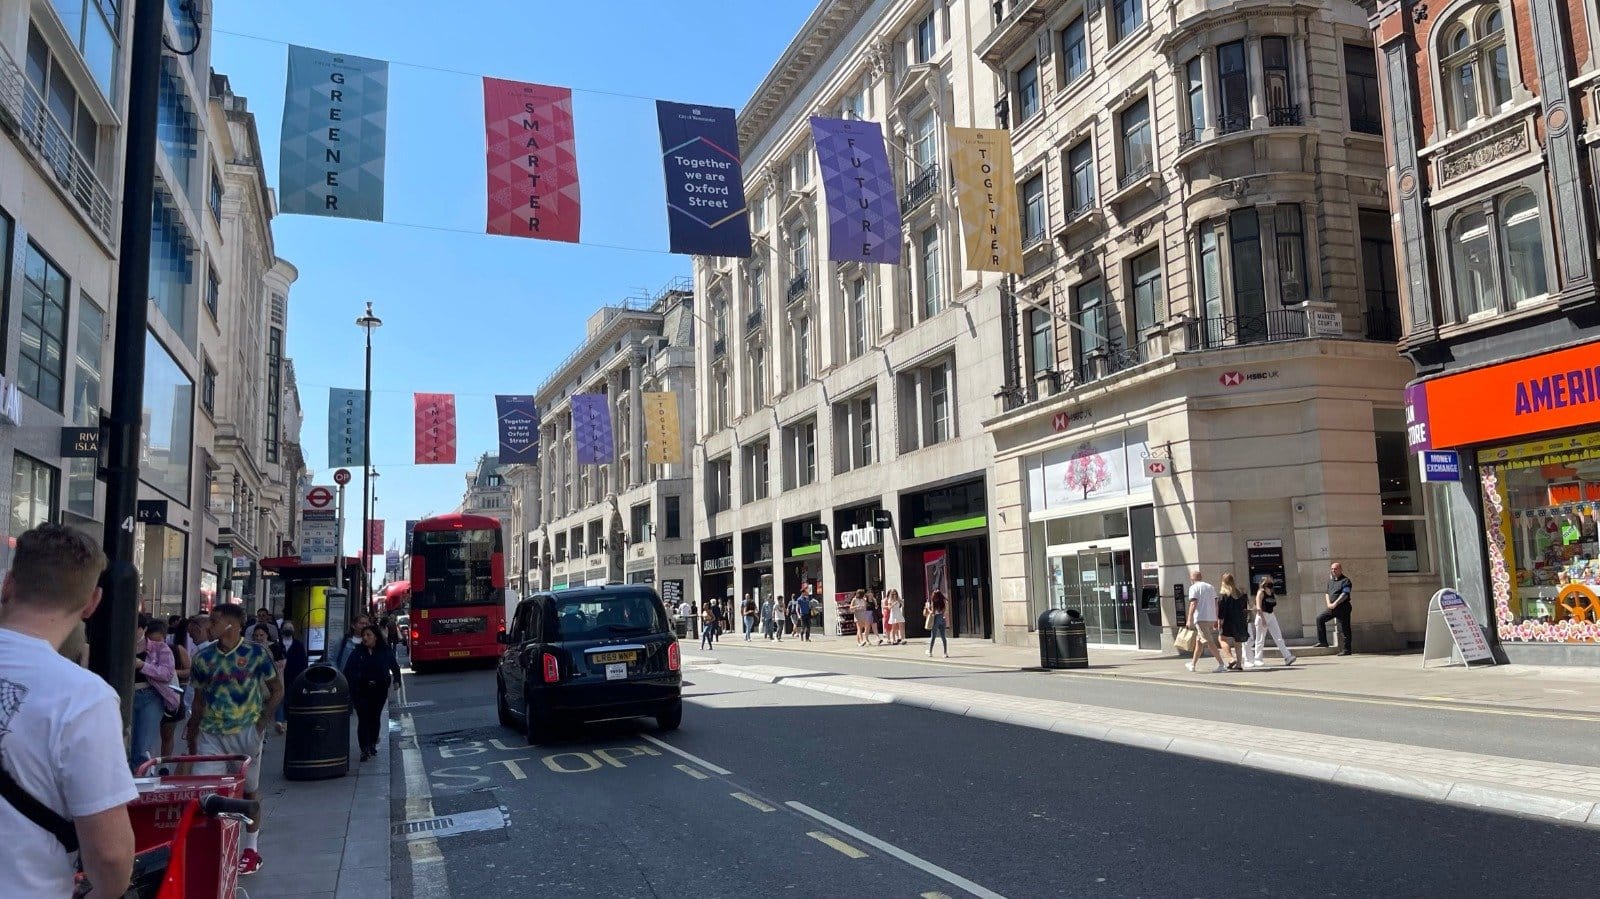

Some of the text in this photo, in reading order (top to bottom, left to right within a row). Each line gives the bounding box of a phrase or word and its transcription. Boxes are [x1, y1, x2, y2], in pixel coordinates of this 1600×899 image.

[325, 72, 345, 210] GREENER
[523, 102, 541, 232] SMARTER
[674, 155, 732, 170] Together
[684, 171, 726, 182] we are
[684, 183, 729, 195] Oxford
[847, 138, 872, 256] FUTURE
[688, 196, 729, 209] Street
[979, 149, 999, 266] TOGETHER
[1317, 313, 1336, 321] MARKET
[1246, 370, 1280, 381] HSBC UK
[345, 399, 353, 464] GREENER
[431, 402, 440, 462] SMARTER
[588, 404, 599, 461] FUTURE
[658, 402, 668, 460] TOGETHER
[1430, 454, 1452, 463] MONEY
[1426, 463, 1459, 473] EXCHANGE
[121, 515, 134, 533] 4
[841, 521, 875, 549] schuh
[596, 653, 617, 663] LR69
[430, 745, 663, 788] STOP
[140, 792, 172, 803] LEASE
[173, 791, 195, 801] TAKE
